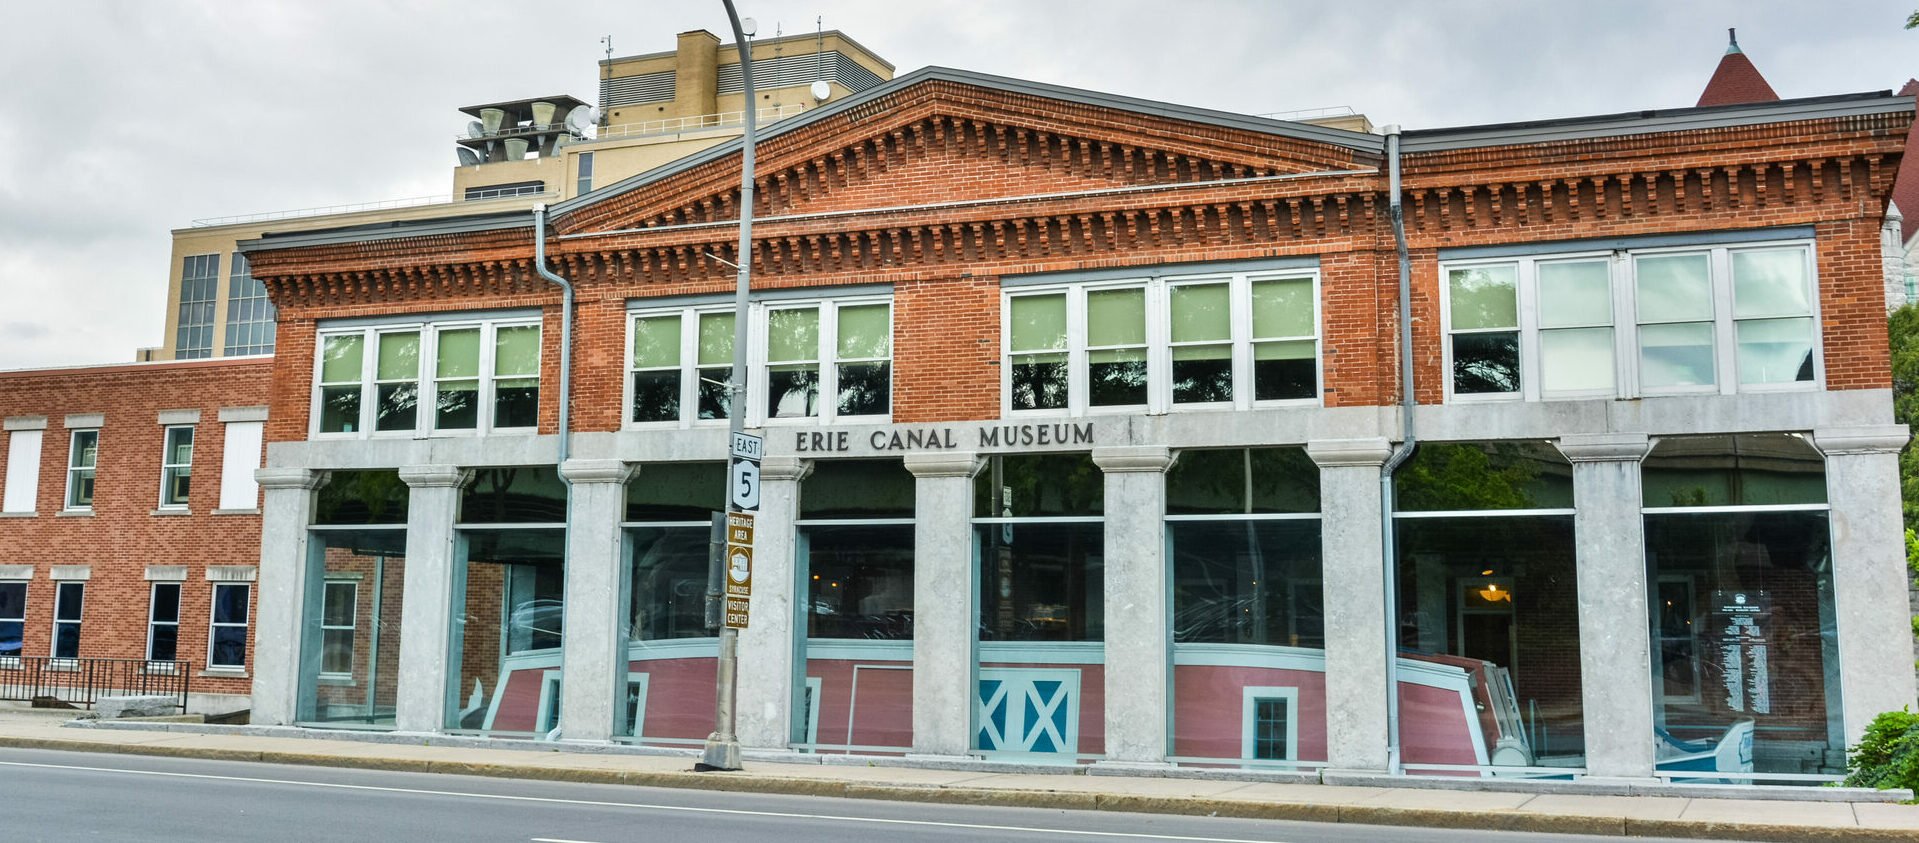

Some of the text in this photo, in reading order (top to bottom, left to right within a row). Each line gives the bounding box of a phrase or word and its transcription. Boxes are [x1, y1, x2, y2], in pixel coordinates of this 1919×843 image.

[795, 422, 1094, 451] ERIE CANAL MUSEUM
[737, 438, 758, 455] EAST
[741, 471, 751, 498] 5
[729, 516, 753, 528] HERITAGE
[734, 529, 748, 540] AREA
[729, 584, 749, 594] SYRACUSE
[727, 600, 749, 612] VISITOR
[727, 613, 748, 625] CENTER
